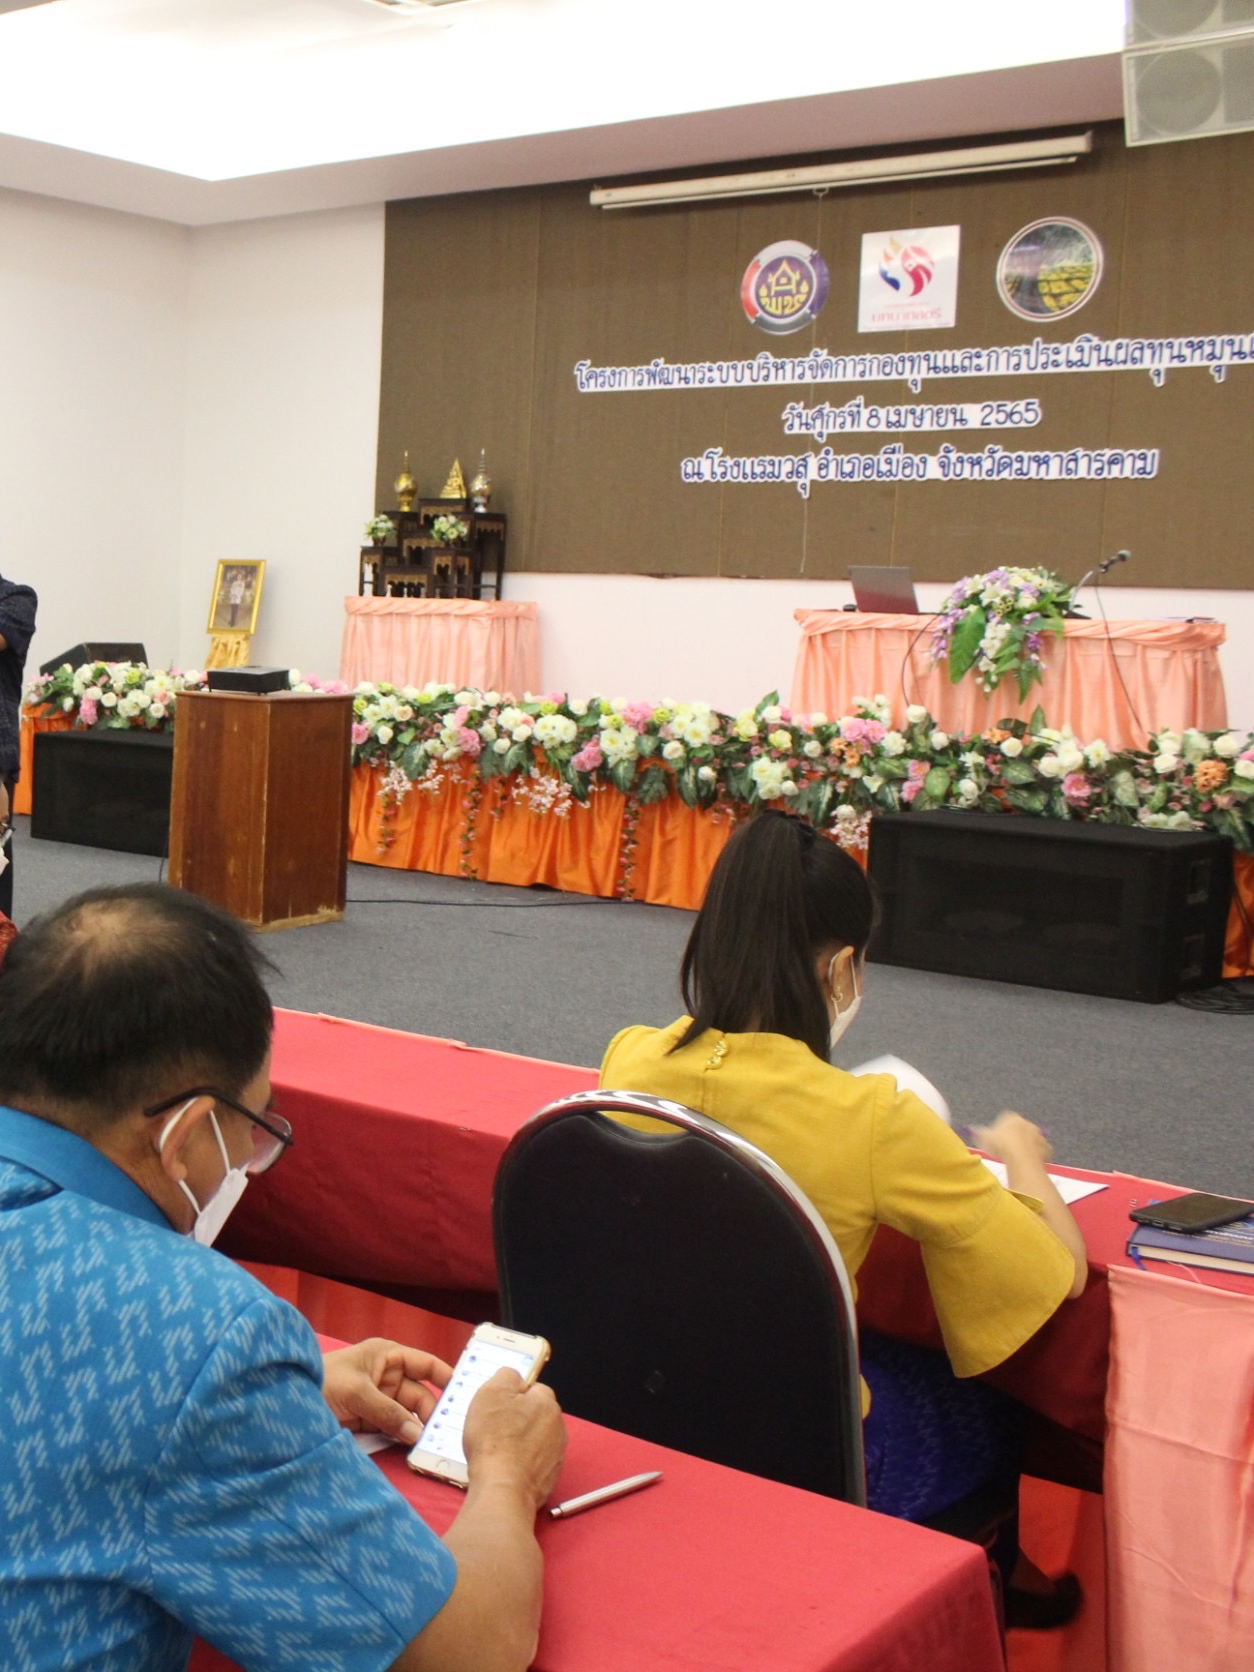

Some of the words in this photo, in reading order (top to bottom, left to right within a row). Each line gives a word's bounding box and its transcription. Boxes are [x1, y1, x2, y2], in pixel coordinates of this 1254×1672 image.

[980, 401, 1040, 426] 2565
[817, 444, 928, 479] อำเภอเมือง
[937, 445, 1157, 478] จังหวัดมหาสารคาม
